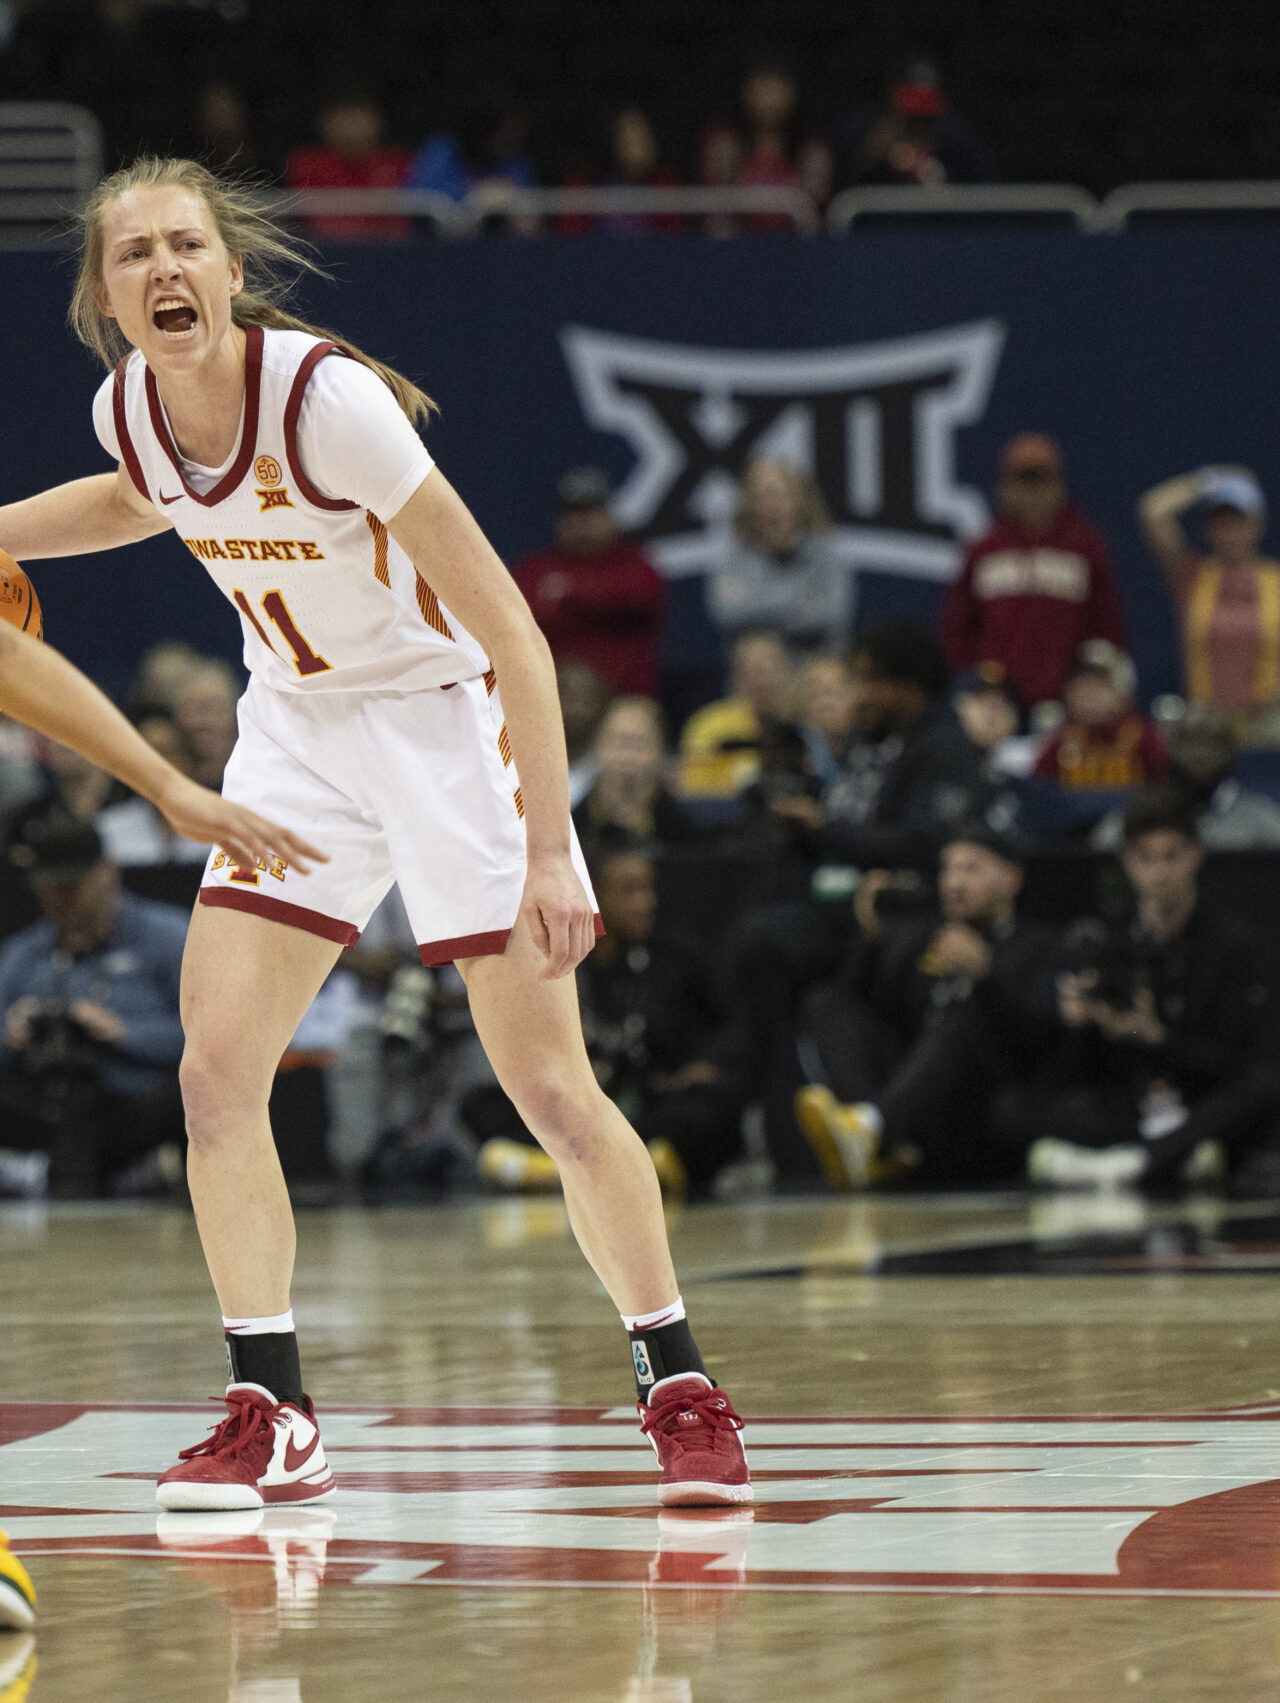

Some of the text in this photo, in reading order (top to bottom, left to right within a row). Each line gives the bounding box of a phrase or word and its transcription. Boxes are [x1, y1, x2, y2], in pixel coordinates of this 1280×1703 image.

[257, 463, 278, 480] 50
[223, 538, 325, 562] STATE
[232, 588, 334, 678] 11
